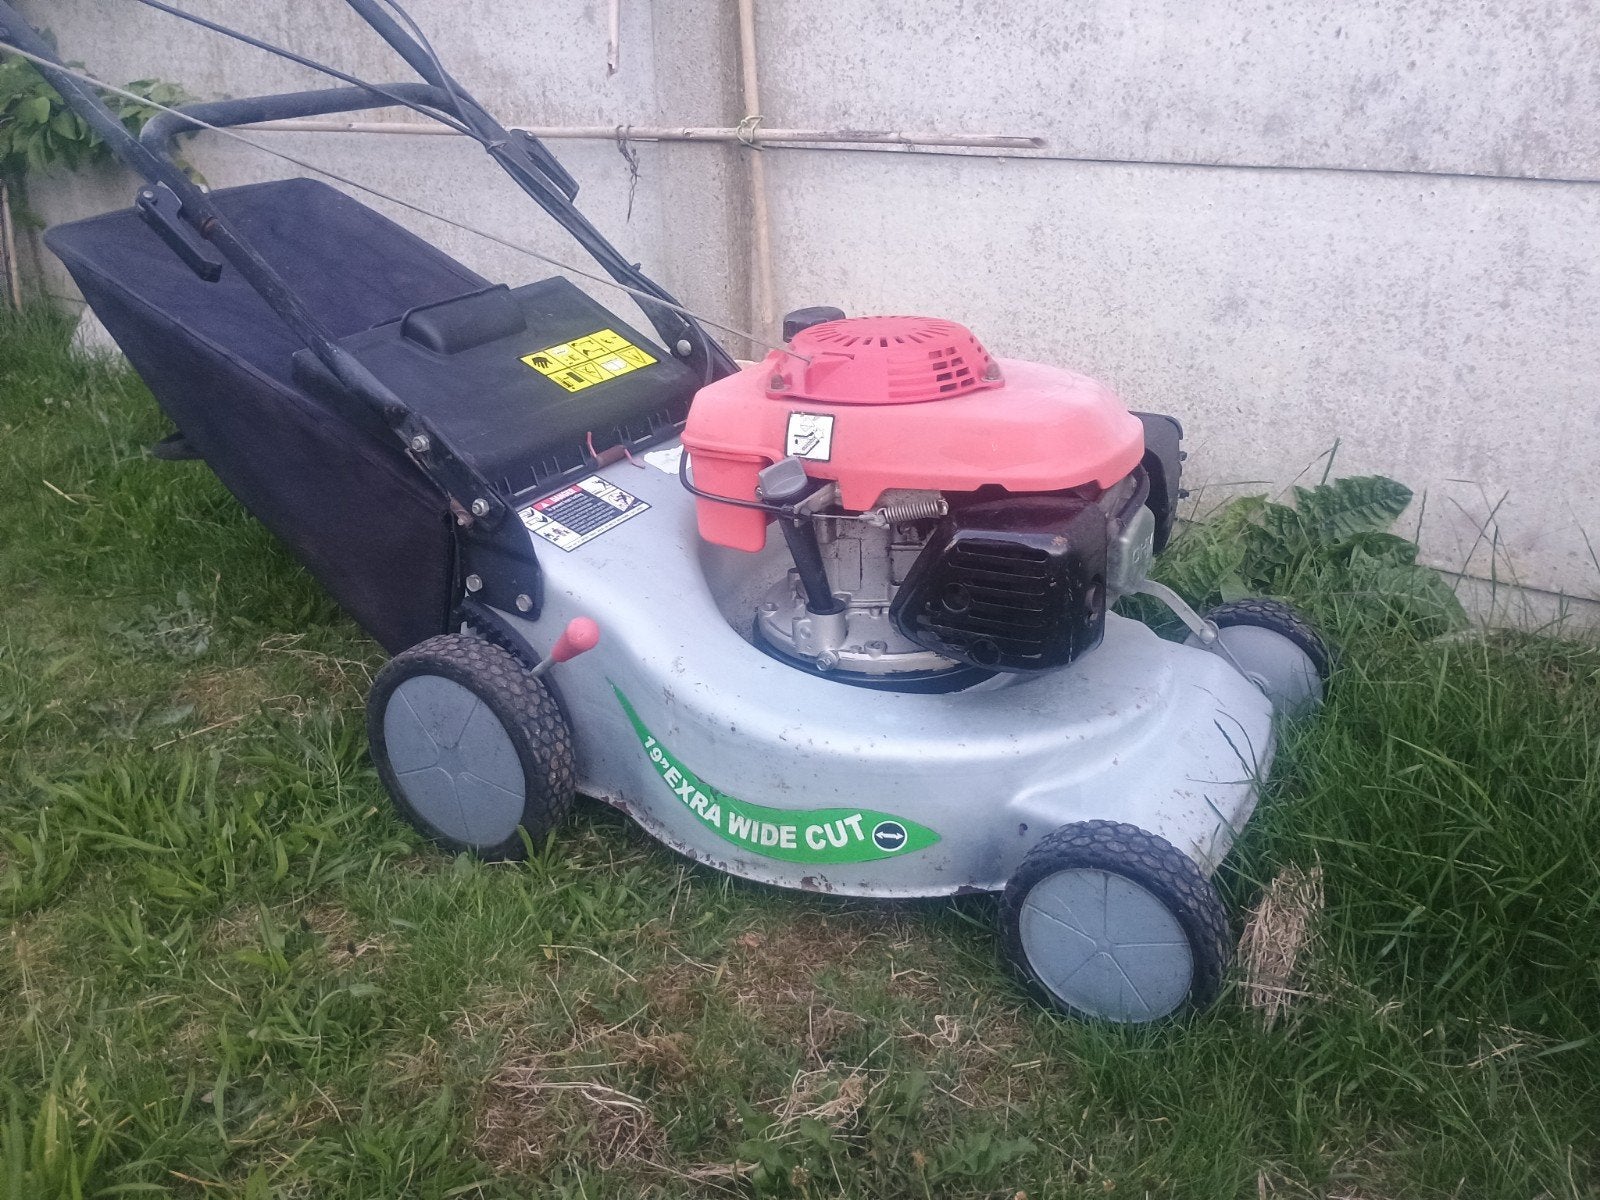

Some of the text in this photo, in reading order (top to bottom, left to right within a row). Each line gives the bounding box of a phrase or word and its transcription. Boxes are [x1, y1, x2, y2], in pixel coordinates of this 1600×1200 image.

[664, 766, 721, 828] EXRA
[728, 812, 797, 849] WIDE
[805, 813, 866, 850] CUT
